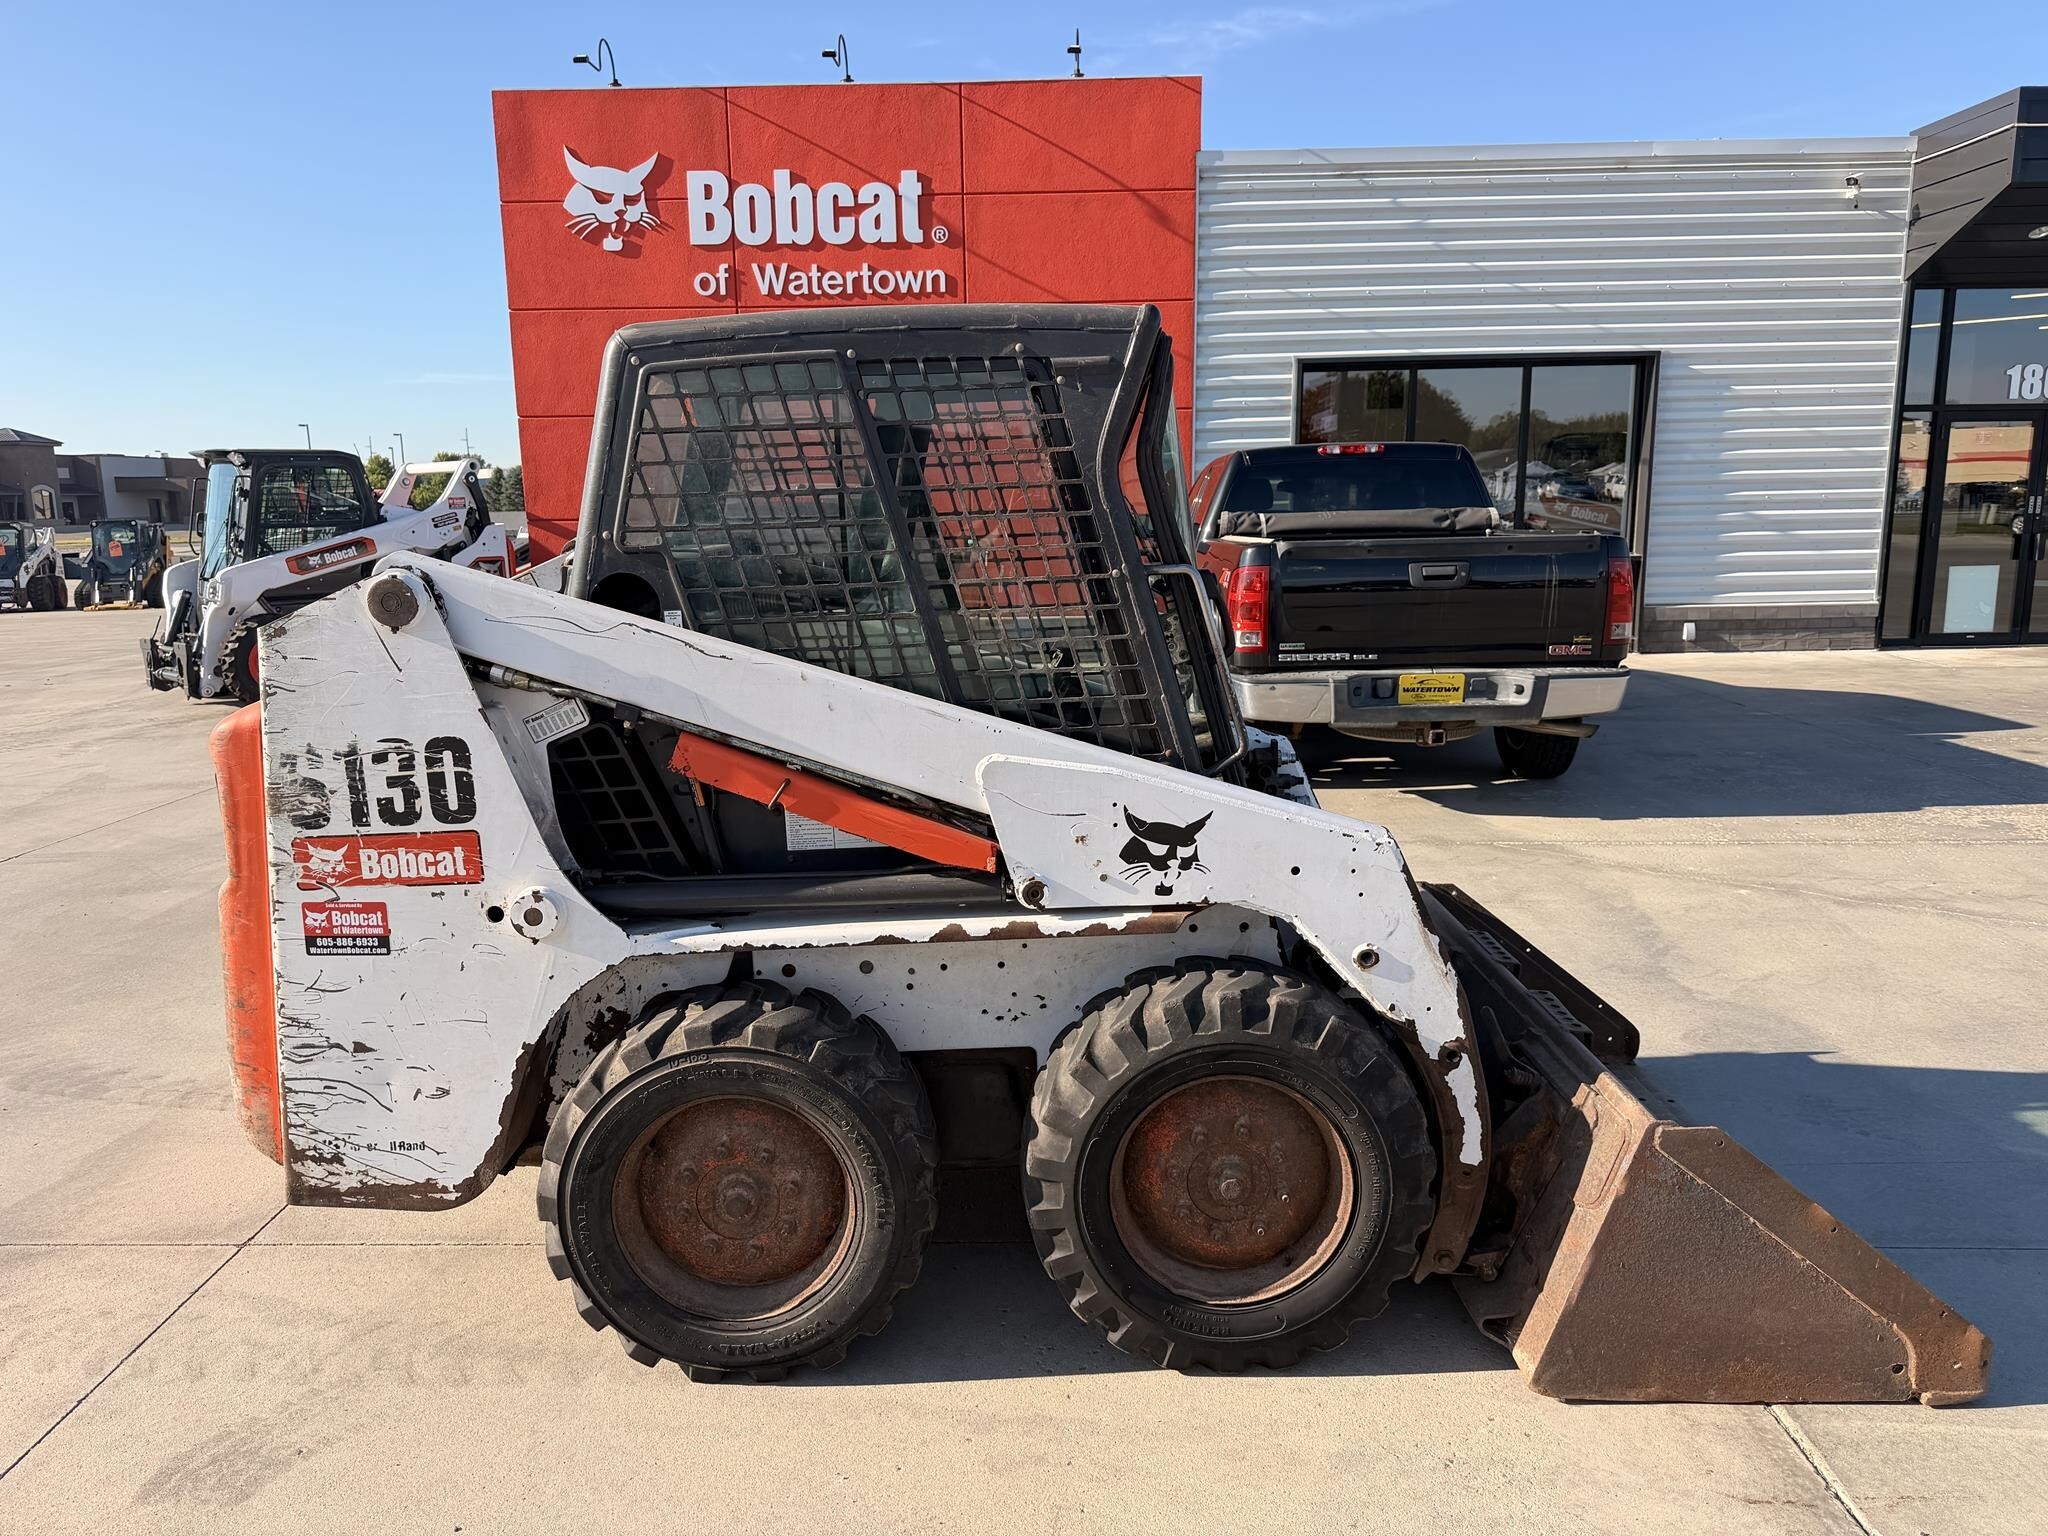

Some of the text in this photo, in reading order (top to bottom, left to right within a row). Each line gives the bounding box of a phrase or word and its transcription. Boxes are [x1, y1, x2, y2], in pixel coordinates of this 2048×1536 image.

[686, 169, 924, 246] Bobcat
[693, 262, 947, 296] of Watertown
[2006, 363, 2048, 400] 18
[1571, 506, 1609, 524] Bobcat
[323, 545, 358, 564] Bobcat
[1279, 653, 1350, 661] SIERRA
[1548, 645, 1593, 656] GMC
[359, 846, 467, 880] Bobcat
[331, 910, 383, 926] Bobcat
[333, 926, 384, 934] of Watertown
[309, 946, 387, 954] WatertownBobcat.com
[316, 937, 379, 946] 605-886-6933
